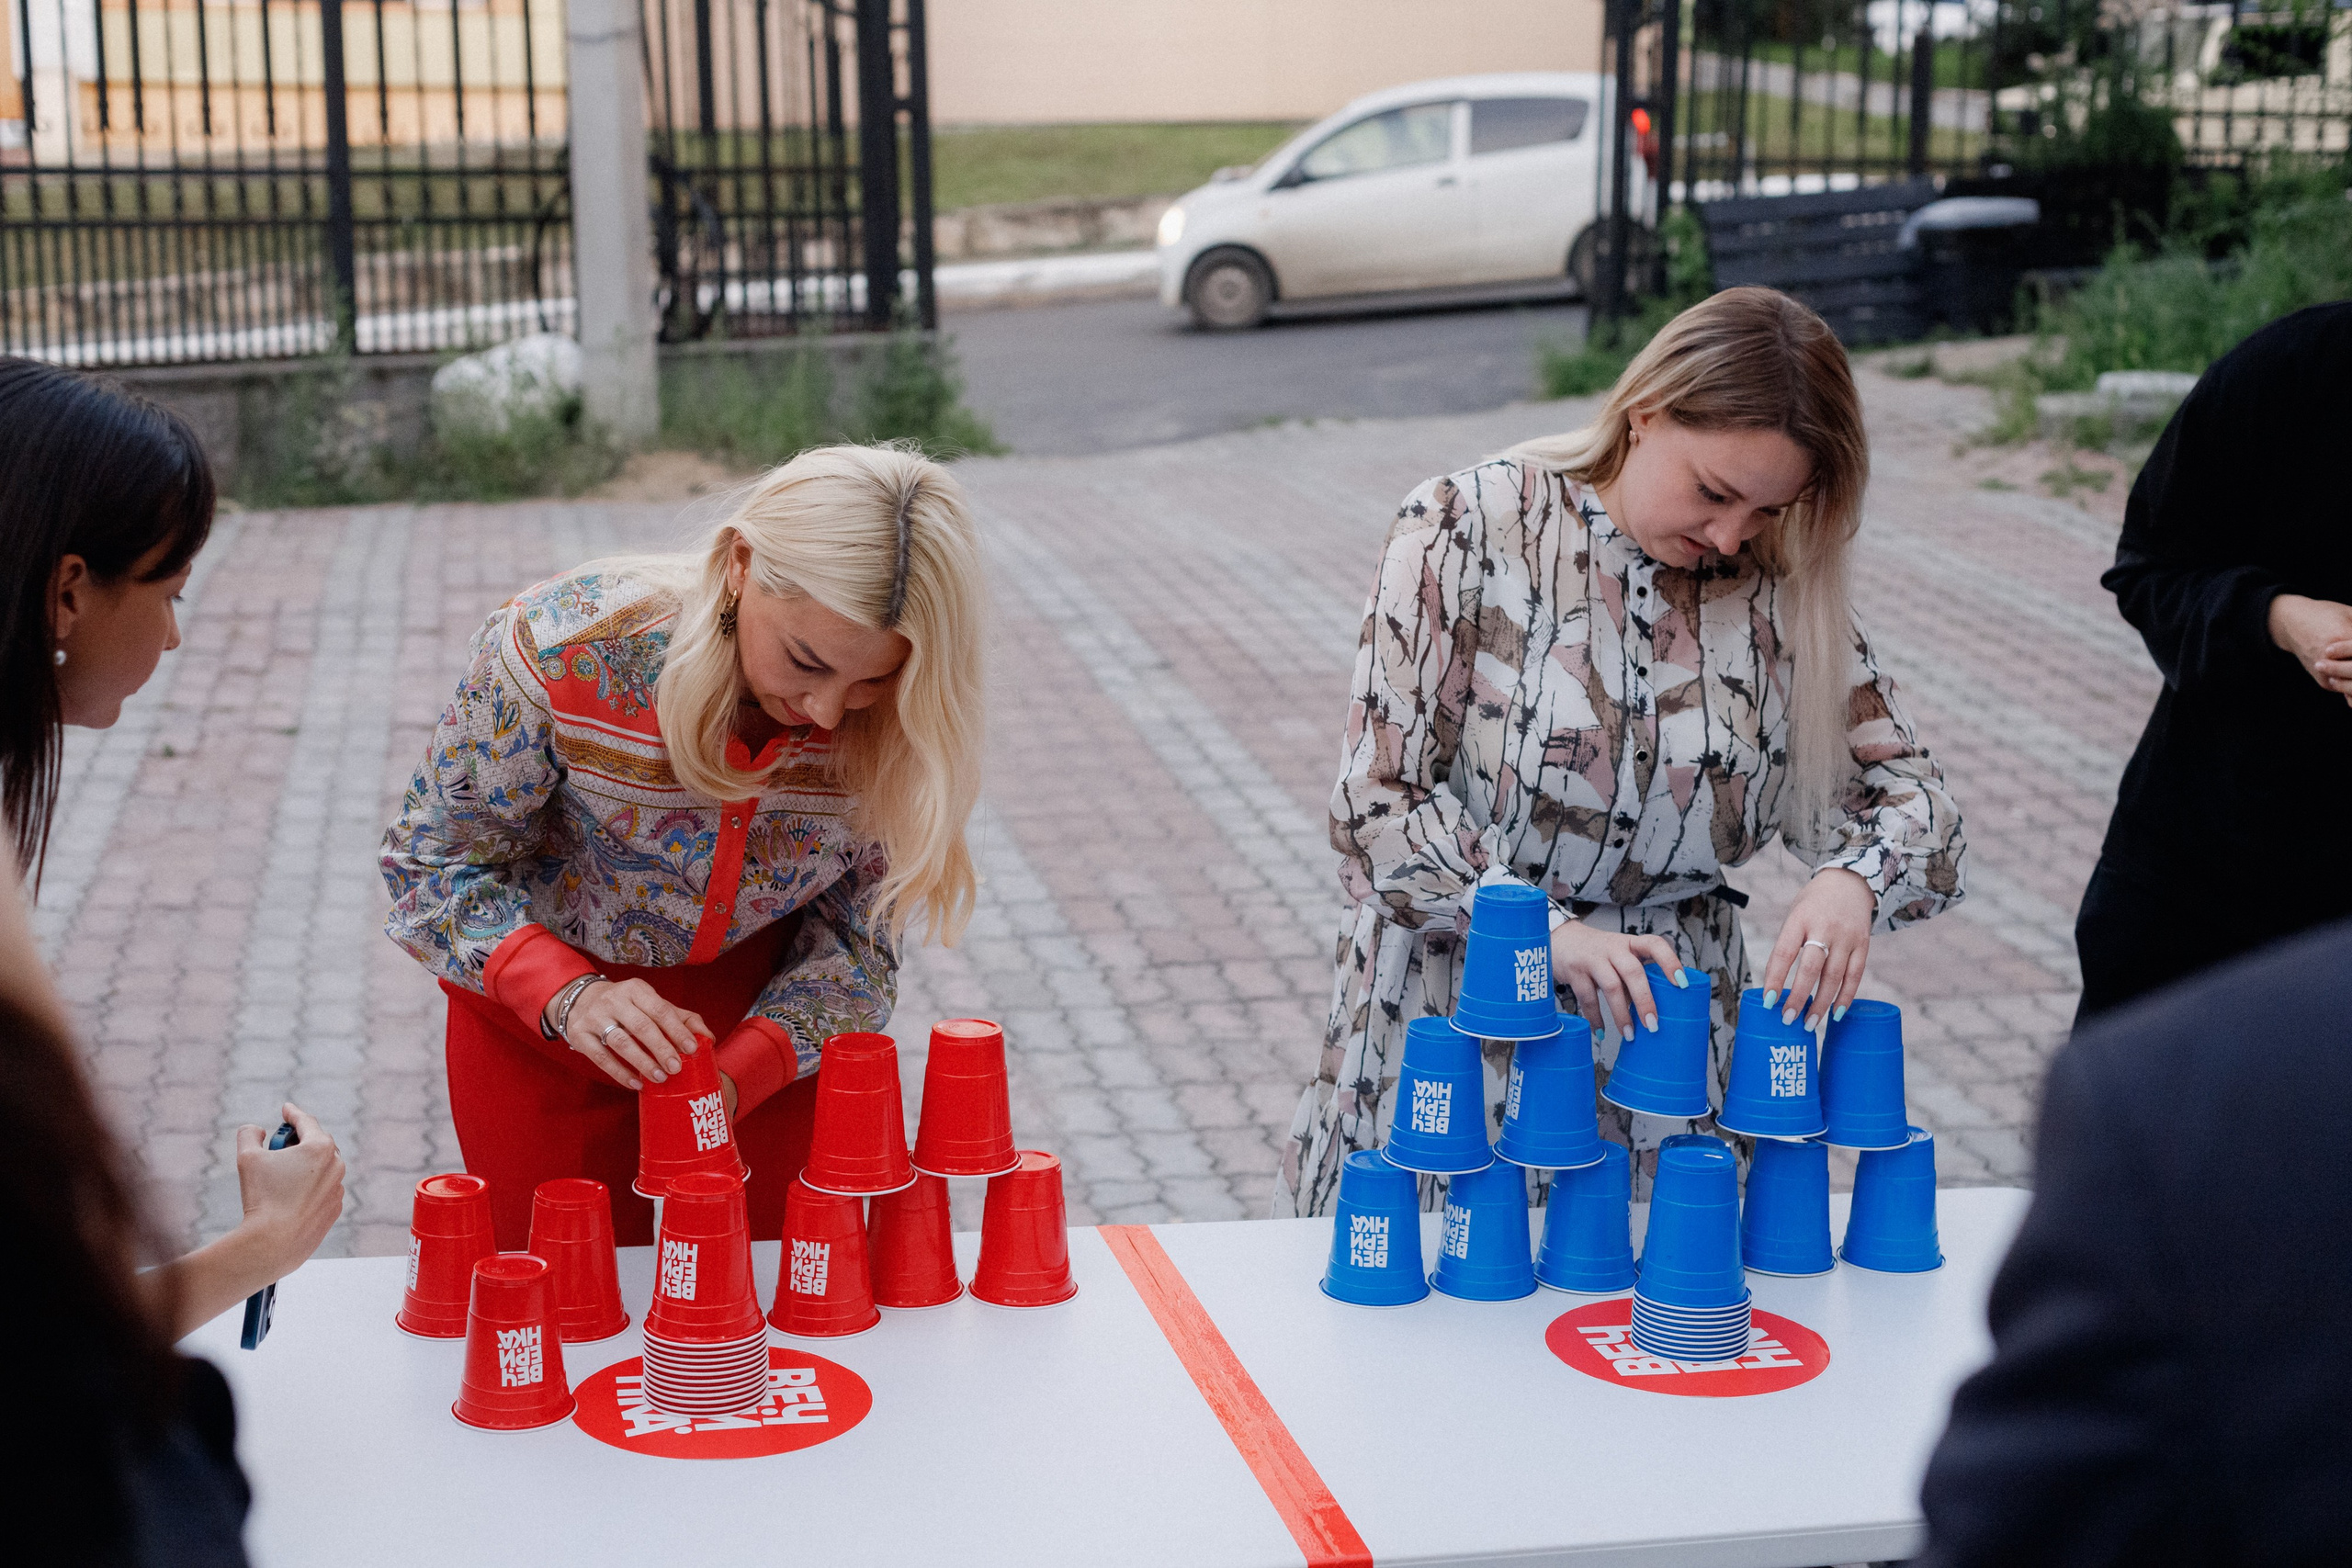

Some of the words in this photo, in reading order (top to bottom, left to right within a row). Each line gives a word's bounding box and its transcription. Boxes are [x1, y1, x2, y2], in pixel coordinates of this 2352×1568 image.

[1514, 945, 1547, 967] НКА
[1515, 963, 1548, 985] ЕРИ
[1517, 980, 1548, 1002] ВЕЧ
[1770, 1044, 1807, 1064] НКА
[1770, 1062, 1807, 1080] ЕРИ
[1412, 1078, 1453, 1100] НКА
[1770, 1079, 1807, 1098] ВЕЧ
[688, 1089, 723, 1117] НКА
[1412, 1096, 1451, 1117] ЕРИ
[692, 1107, 727, 1135] ЕРИ
[1411, 1113, 1450, 1134] ВЕЧ
[696, 1125, 729, 1152] ВЕЧ
[1350, 1213, 1390, 1234] НКА
[662, 1237, 698, 1263] НКА
[791, 1237, 831, 1261] НКА
[1351, 1231, 1388, 1251] ЕРИ
[662, 1257, 696, 1281] ЕРИ
[791, 1255, 829, 1279] ЕРИ
[1351, 1248, 1388, 1269] ВЕЧ
[661, 1275, 696, 1301] ВЕЧ
[789, 1273, 828, 1297] ВЕЧ
[496, 1325, 542, 1350] НКА
[499, 1344, 543, 1369] ЕРИ
[501, 1362, 544, 1388] ВЕЧ
[761, 1367, 829, 1426] ВЕЧ
